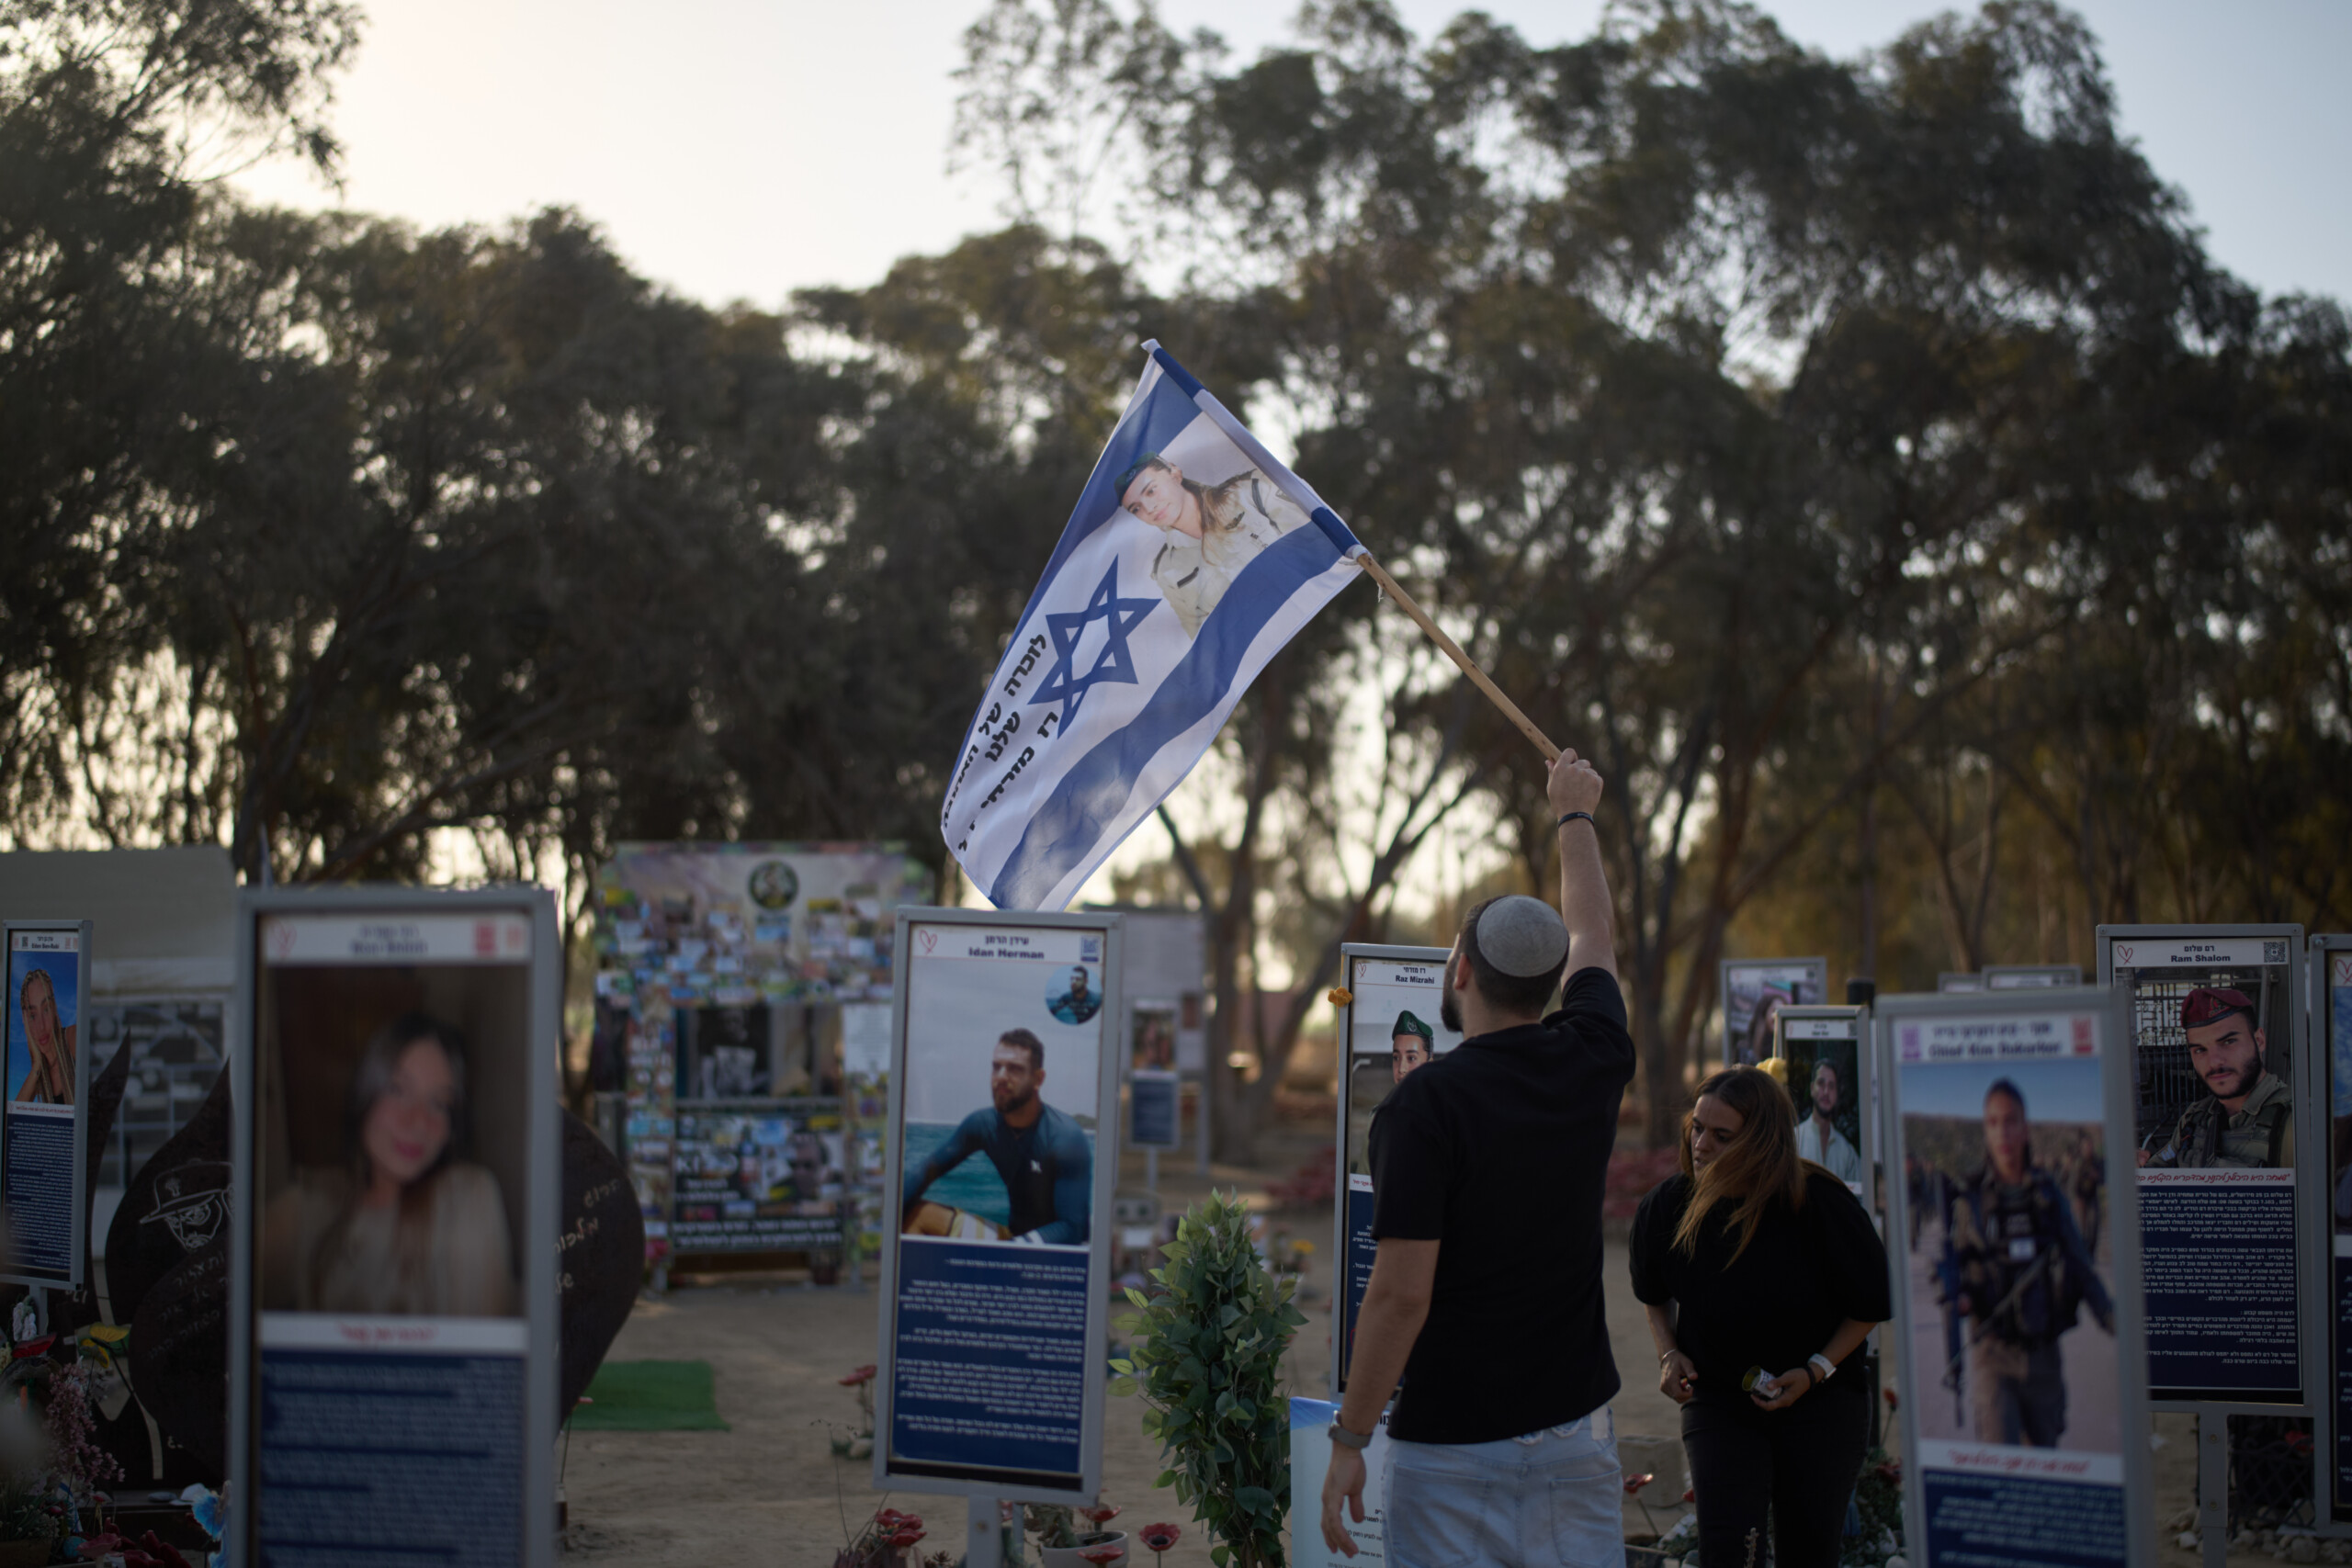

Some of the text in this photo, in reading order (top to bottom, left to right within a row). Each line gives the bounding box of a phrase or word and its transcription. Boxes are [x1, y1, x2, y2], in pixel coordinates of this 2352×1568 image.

[1003, 634, 1046, 697] לזכרה
[978, 702, 1001, 736] של
[1036, 711, 1058, 739] רז
[985, 711, 1021, 762] שלנו
[980, 746, 1035, 809] מזרחי
[968, 947, 1045, 960] Idan Herman
[2170, 953, 2231, 963] Ram Shalom
[2184, 944, 2203, 953] שלום
[1395, 975, 1435, 985] Raz Mizrahi
